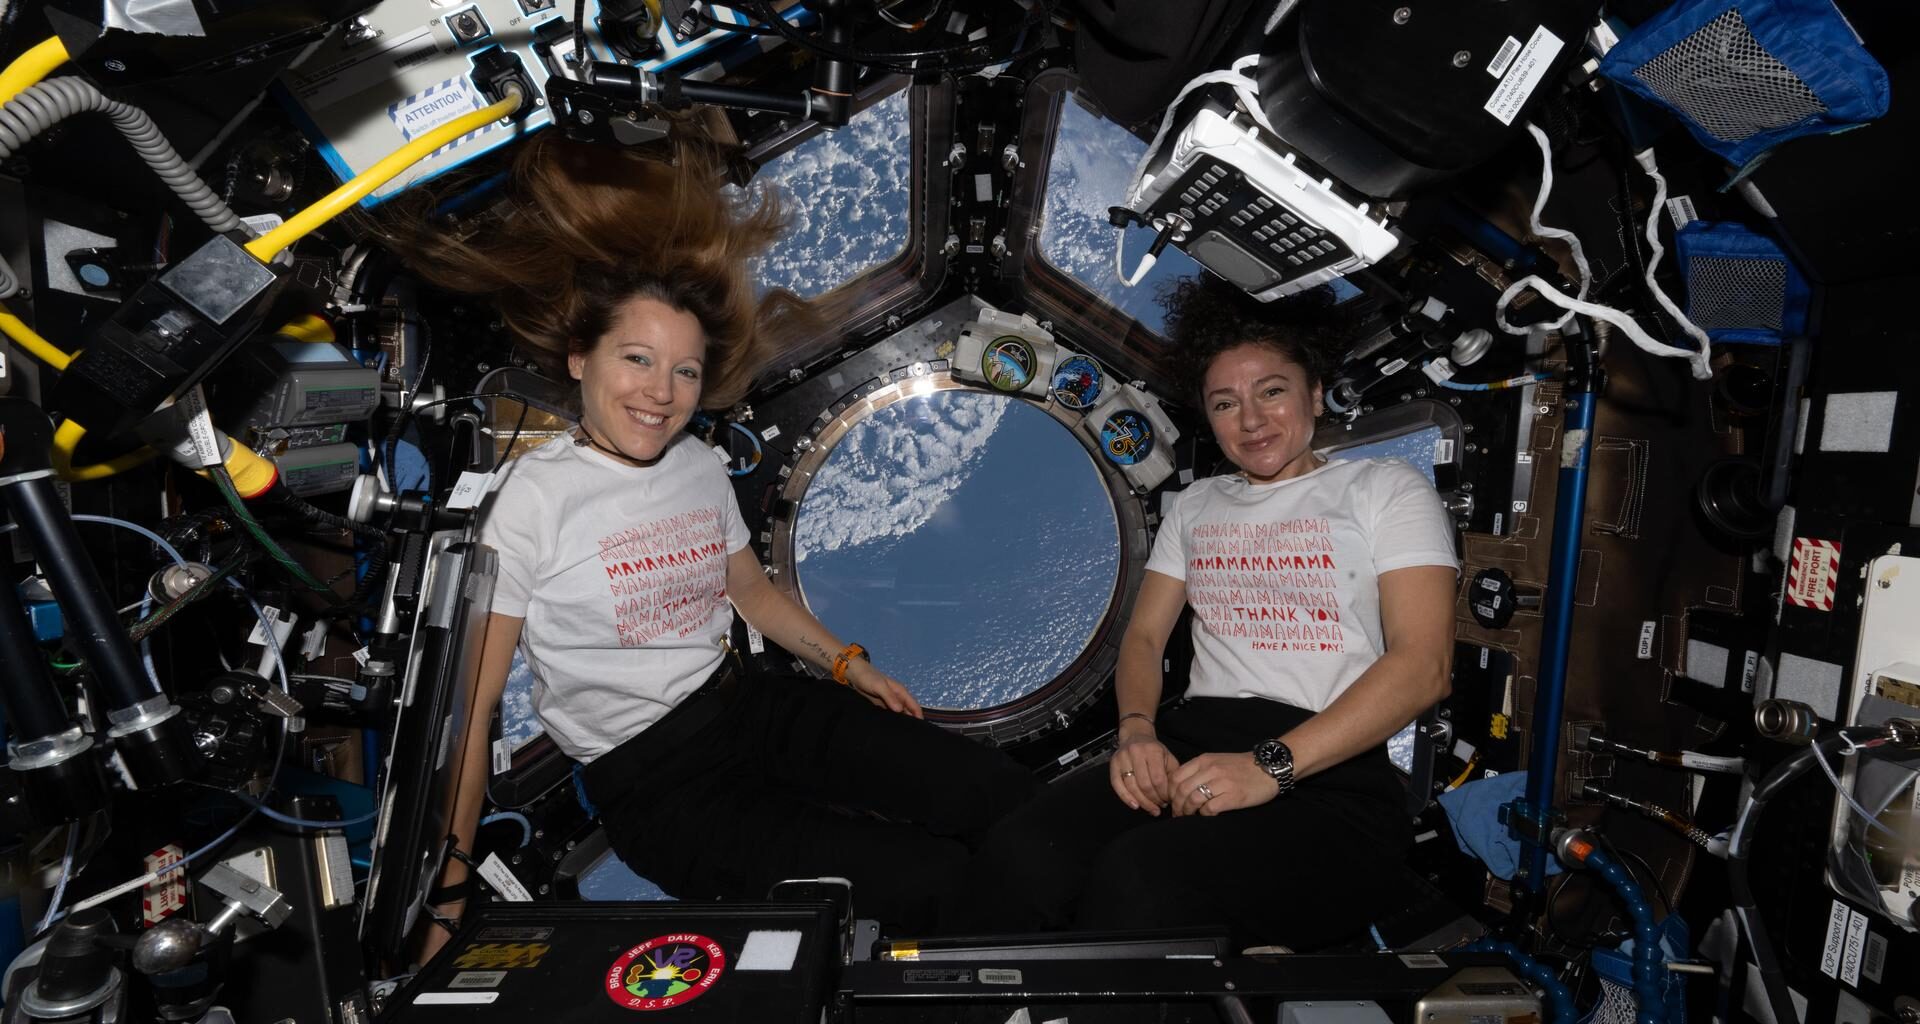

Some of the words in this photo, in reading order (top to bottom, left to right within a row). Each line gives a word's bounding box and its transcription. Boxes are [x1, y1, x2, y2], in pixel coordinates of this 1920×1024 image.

[430, 18, 441, 27] ON
[509, 17, 521, 26] OFF
[1489, 88, 1505, 109] Cupola
[1503, 75, 1515, 89] ATU
[1512, 61, 1523, 77] Flex
[1519, 48, 1532, 65] Hose
[1529, 32, 1544, 50] Cover
[404, 90, 464, 124] ATTENTION
[1504, 107, 1516, 120] S/N
[1189, 554, 1336, 571] MAMAMAMAMAMA
[1811, 549, 1822, 576] PORT
[1798, 561, 1808, 596] EMERGENCY
[1806, 577, 1818, 598] FIRE
[663, 593, 704, 616] THAN
[1233, 606, 1300, 623] THANK
[1304, 607, 1340, 623] YOU
[1251, 641, 1278, 651] HAVE
[1281, 642, 1289, 651] A
[1292, 642, 1316, 652] NICE
[1319, 641, 1344, 654] DAY!
[1640, 624, 1652, 655] CUP1_P1
[1744, 655, 1756, 689] CUP1_P1
[1834, 904, 1846, 922] Brkt
[667, 935, 699, 943] DAVE
[1827, 920, 1843, 954] Support
[627, 941, 653, 959] JEFF
[706, 943, 722, 958] KEN
[1823, 953, 1835, 975] UOP
[608, 966, 622, 990] BRAD
[700, 967, 721, 988] ERIN
